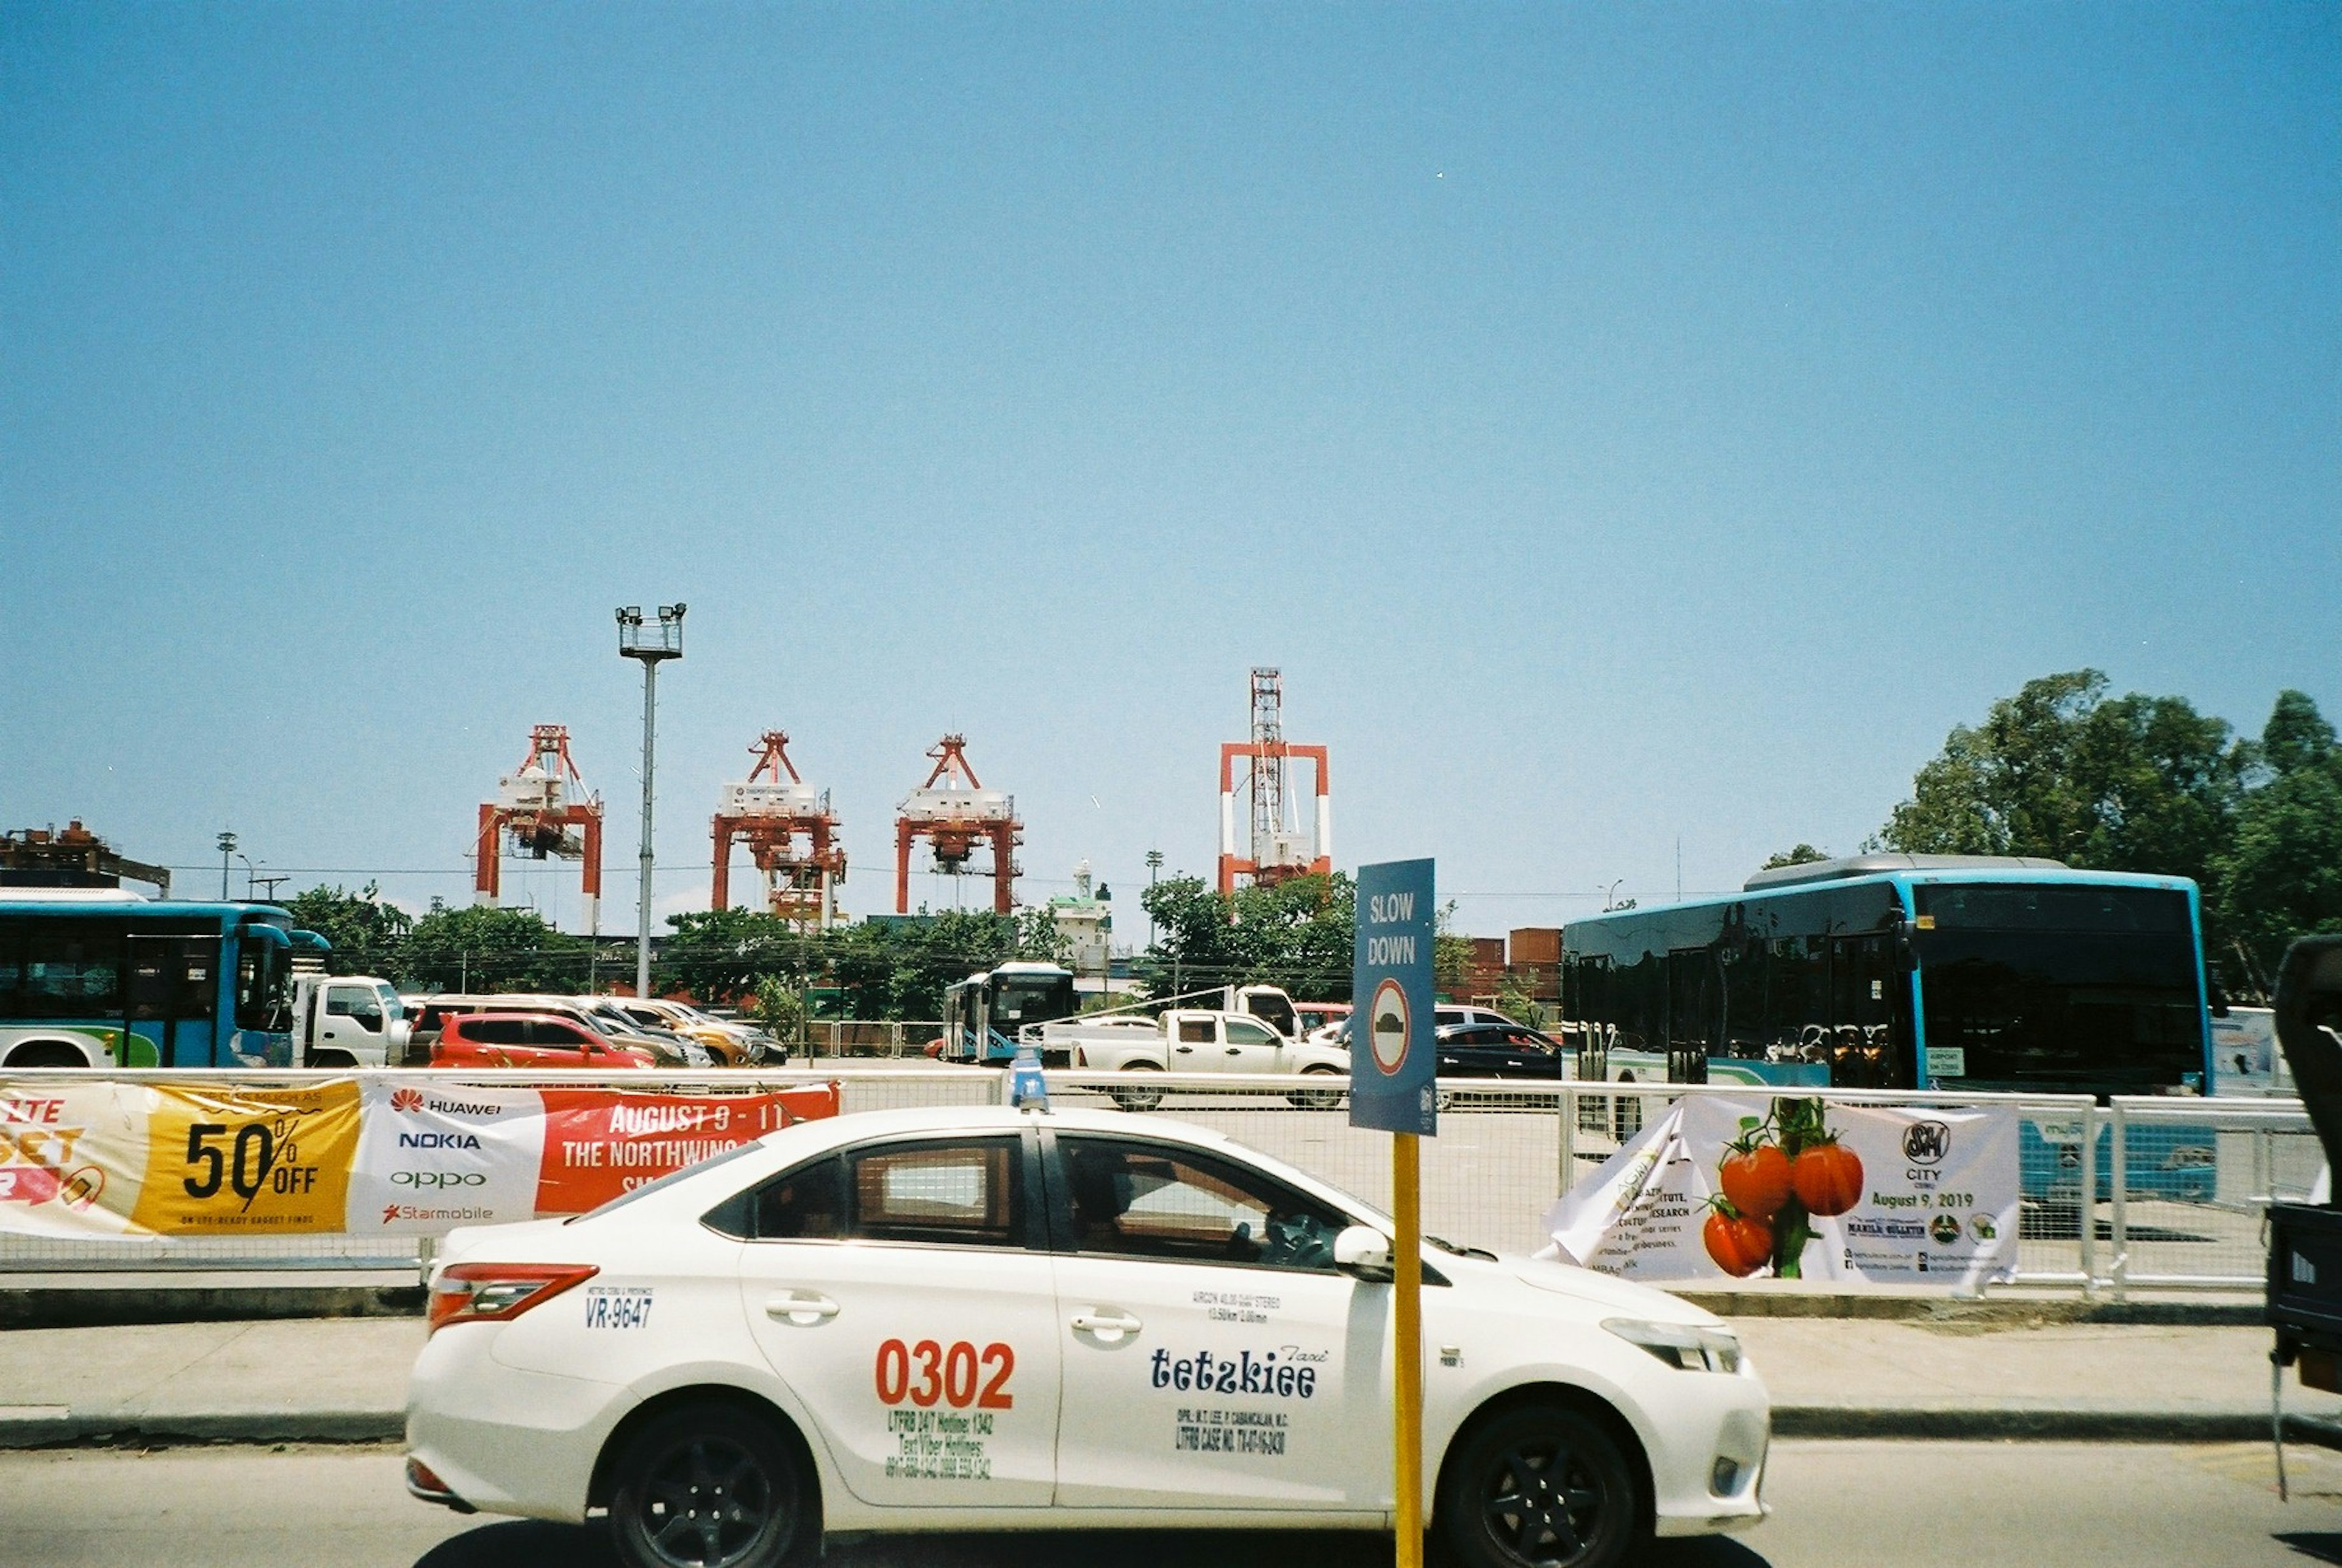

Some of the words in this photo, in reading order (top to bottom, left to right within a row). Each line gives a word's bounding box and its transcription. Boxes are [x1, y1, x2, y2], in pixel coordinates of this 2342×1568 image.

[1370, 893, 1414, 923] SLOW
[1368, 936, 1415, 965] DOWN
[429, 1100, 501, 1115] HUAWEI
[609, 1104, 707, 1133] AUGUST
[714, 1104, 730, 1130] 9
[759, 1104, 783, 1129] 11
[399, 1133, 481, 1150] NOKIA
[562, 1141, 603, 1167] THE
[274, 1167, 318, 1194] OFF
[390, 1171, 487, 1189] oppo
[1907, 1169, 1942, 1181] CITY
[1872, 1191, 1918, 1209] August
[1922, 1194, 1933, 1209] 9,
[1938, 1192, 1974, 1208] 2019
[403, 1205, 493, 1220] Starmobile
[1848, 1223, 1883, 1234] MANILA
[1281, 1345, 1329, 1362] Taxi
[876, 1338, 1015, 1409] 0302
[1151, 1348, 1316, 1399] tetzkiee
